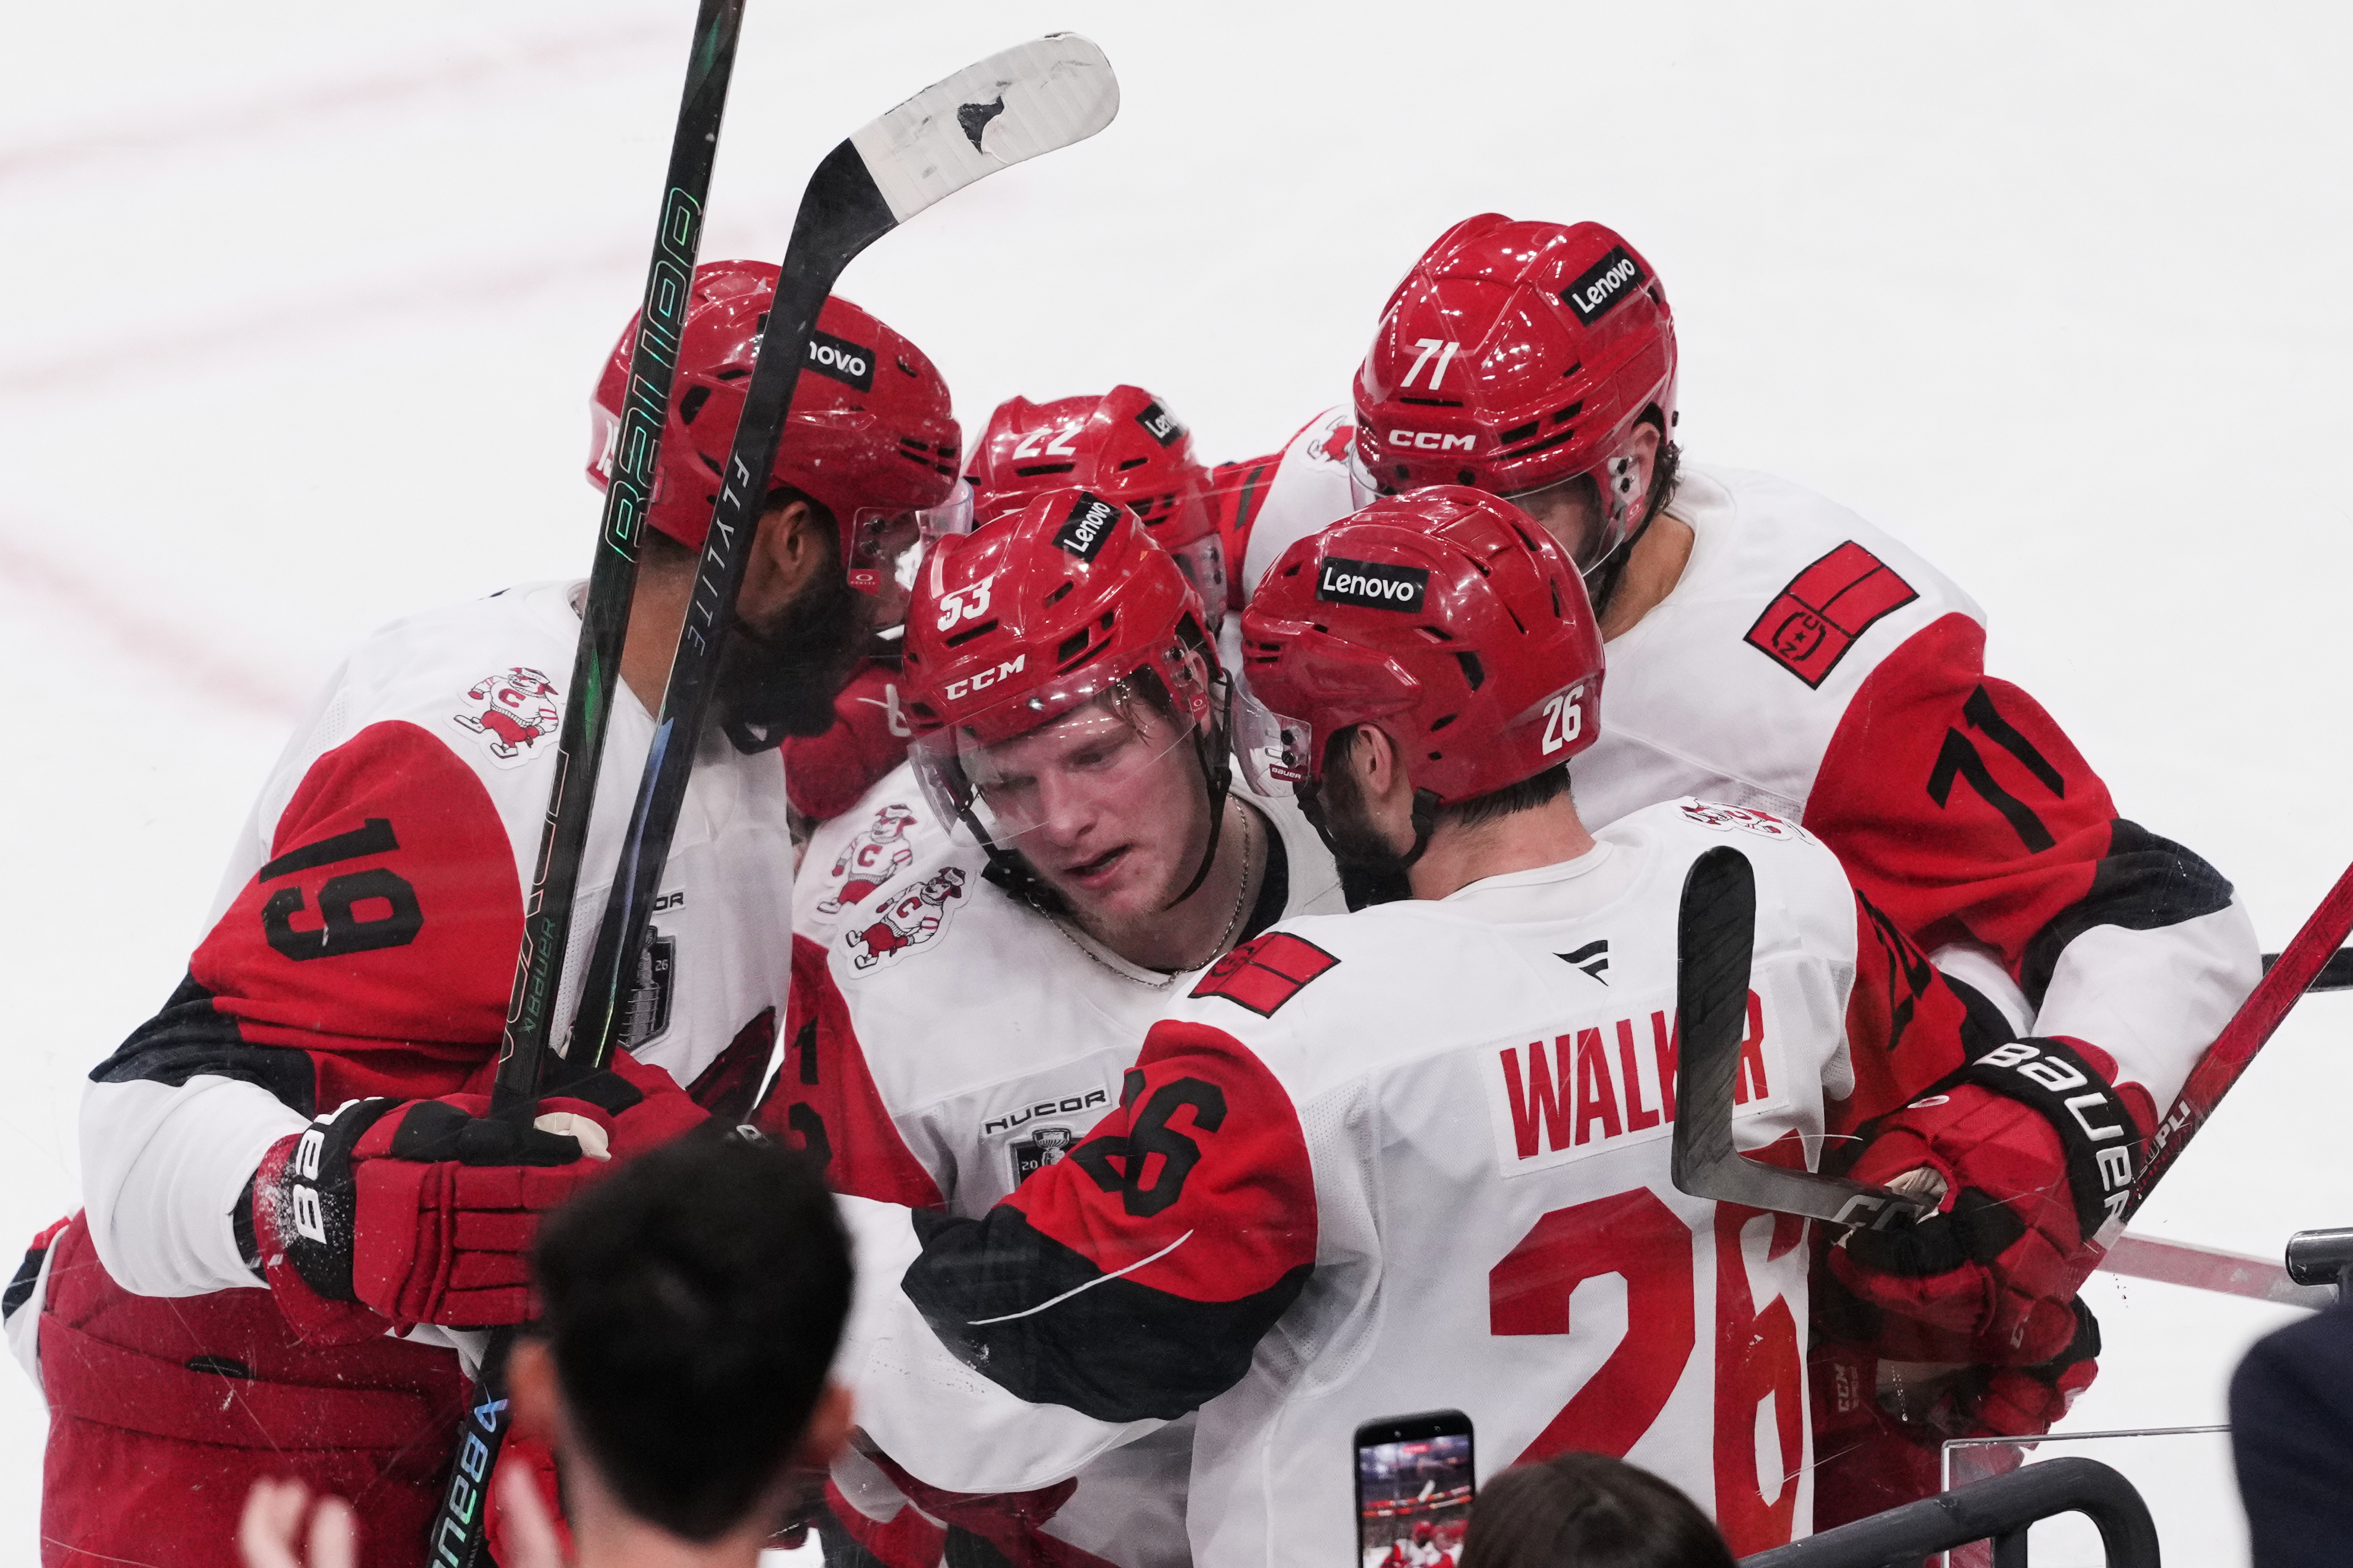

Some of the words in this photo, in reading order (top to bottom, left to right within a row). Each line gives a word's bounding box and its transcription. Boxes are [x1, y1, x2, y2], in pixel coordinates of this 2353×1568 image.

[1572, 257, 1635, 314] Lenovo
[809, 340, 866, 376] novo
[1400, 337, 1460, 390] 71
[1013, 424, 1083, 460] 22
[1388, 429, 1476, 450] CCM
[1064, 501, 1110, 551] Lenovo
[688, 450, 749, 657] FLYLITE
[937, 576, 994, 632] 53
[1322, 566, 1414, 602] Lenovo
[499, 689, 526, 708] C
[944, 654, 1025, 700] CCM
[1542, 684, 1585, 755] 26
[1272, 767, 1301, 780] BAUER
[1926, 683, 2065, 854] 71
[857, 844, 883, 867] C
[259, 818, 424, 961] 19
[897, 897, 923, 919] C
[1500, 988, 1769, 1160] WALKR
[986, 1090, 1106, 1134] NUCOR
[1973, 1043, 2132, 1217] BAUER
